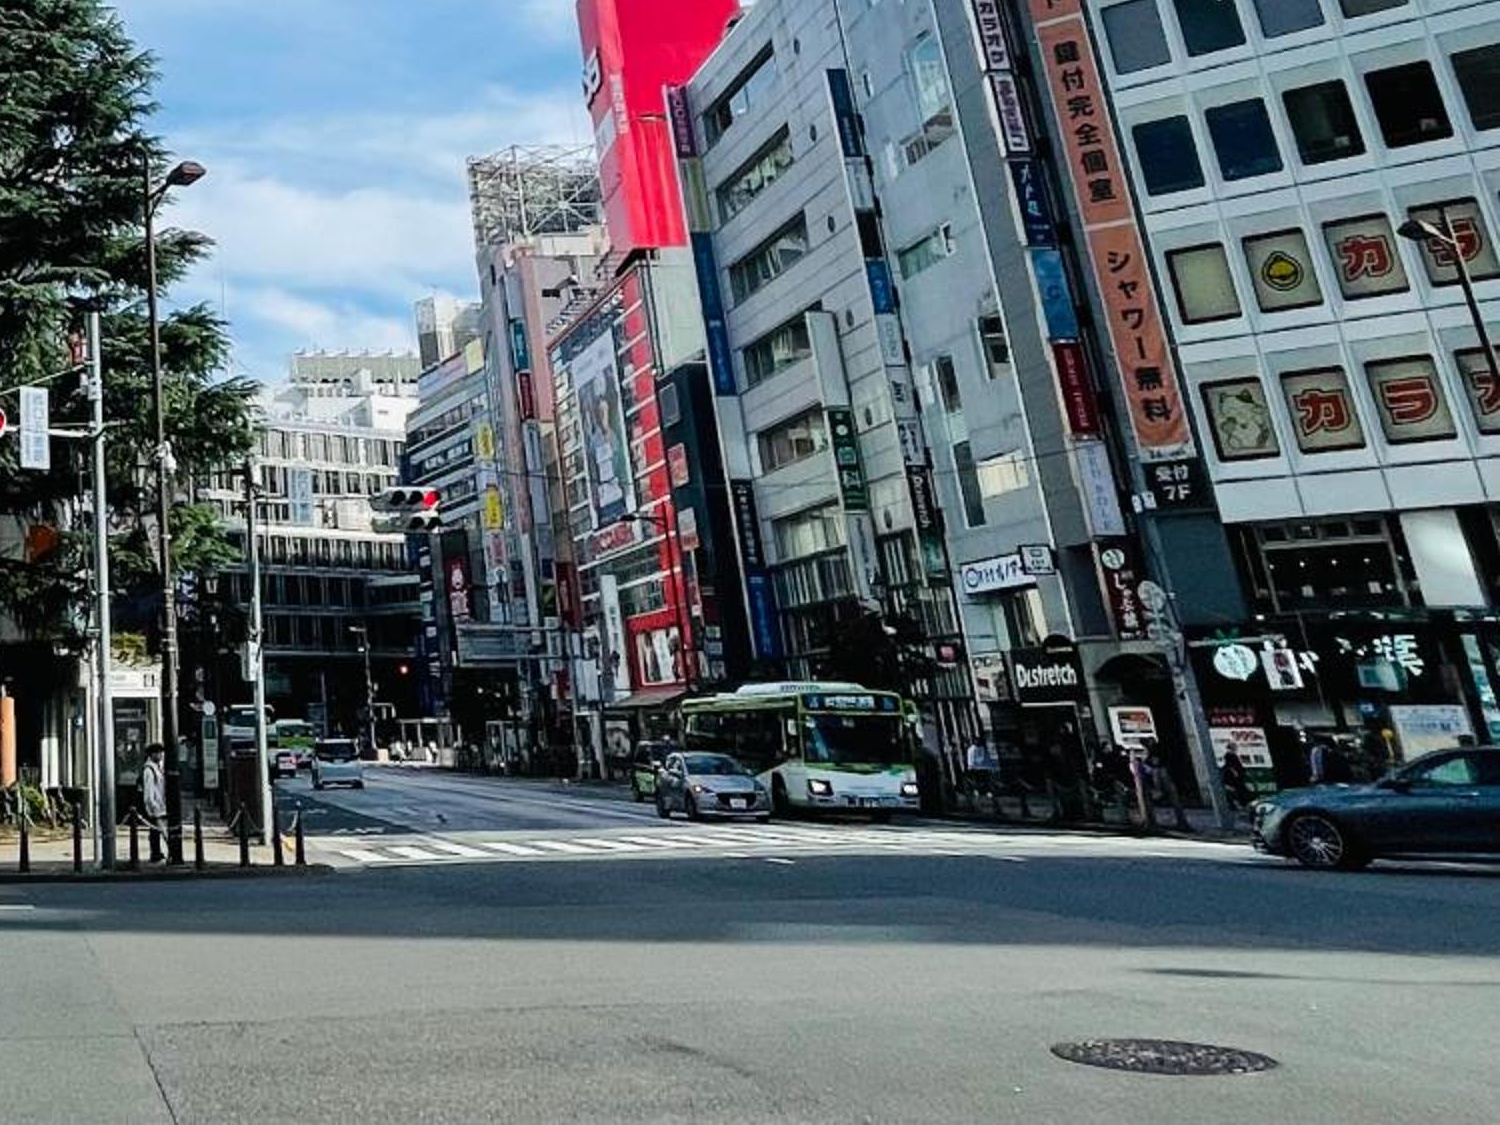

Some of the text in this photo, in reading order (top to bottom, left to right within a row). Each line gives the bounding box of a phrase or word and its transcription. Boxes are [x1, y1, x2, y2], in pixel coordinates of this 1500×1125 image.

[1107, 252, 1172, 422] シャワー無料
[1163, 484, 1192, 501] 7F
